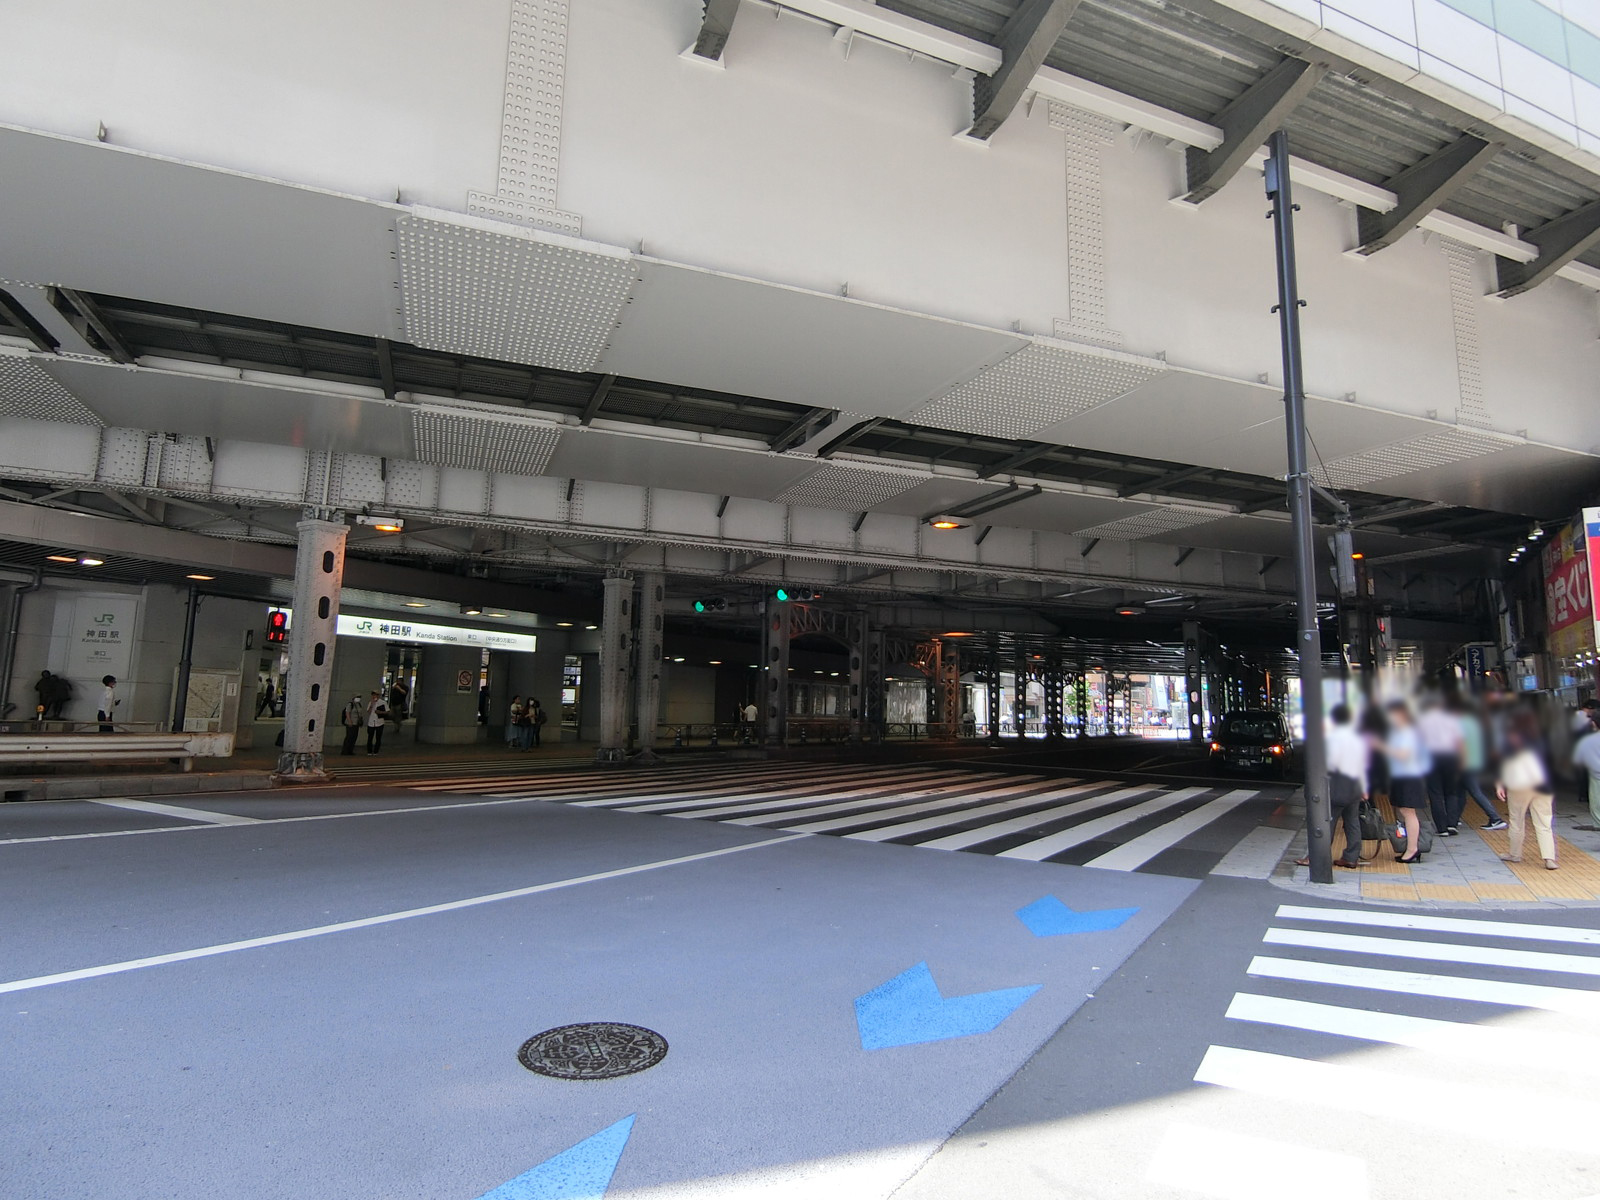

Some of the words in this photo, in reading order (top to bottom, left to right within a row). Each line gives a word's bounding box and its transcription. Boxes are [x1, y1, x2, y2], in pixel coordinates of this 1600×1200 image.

[1555, 559, 1588, 622] 宝くじ
[94, 614, 114, 623] JR
[356, 621, 372, 631] JR
[379, 623, 412, 636] 神田駅
[87, 629, 120, 638] 神田駅
[416, 631, 435, 639] Kanda
[437, 634, 458, 642] Station
